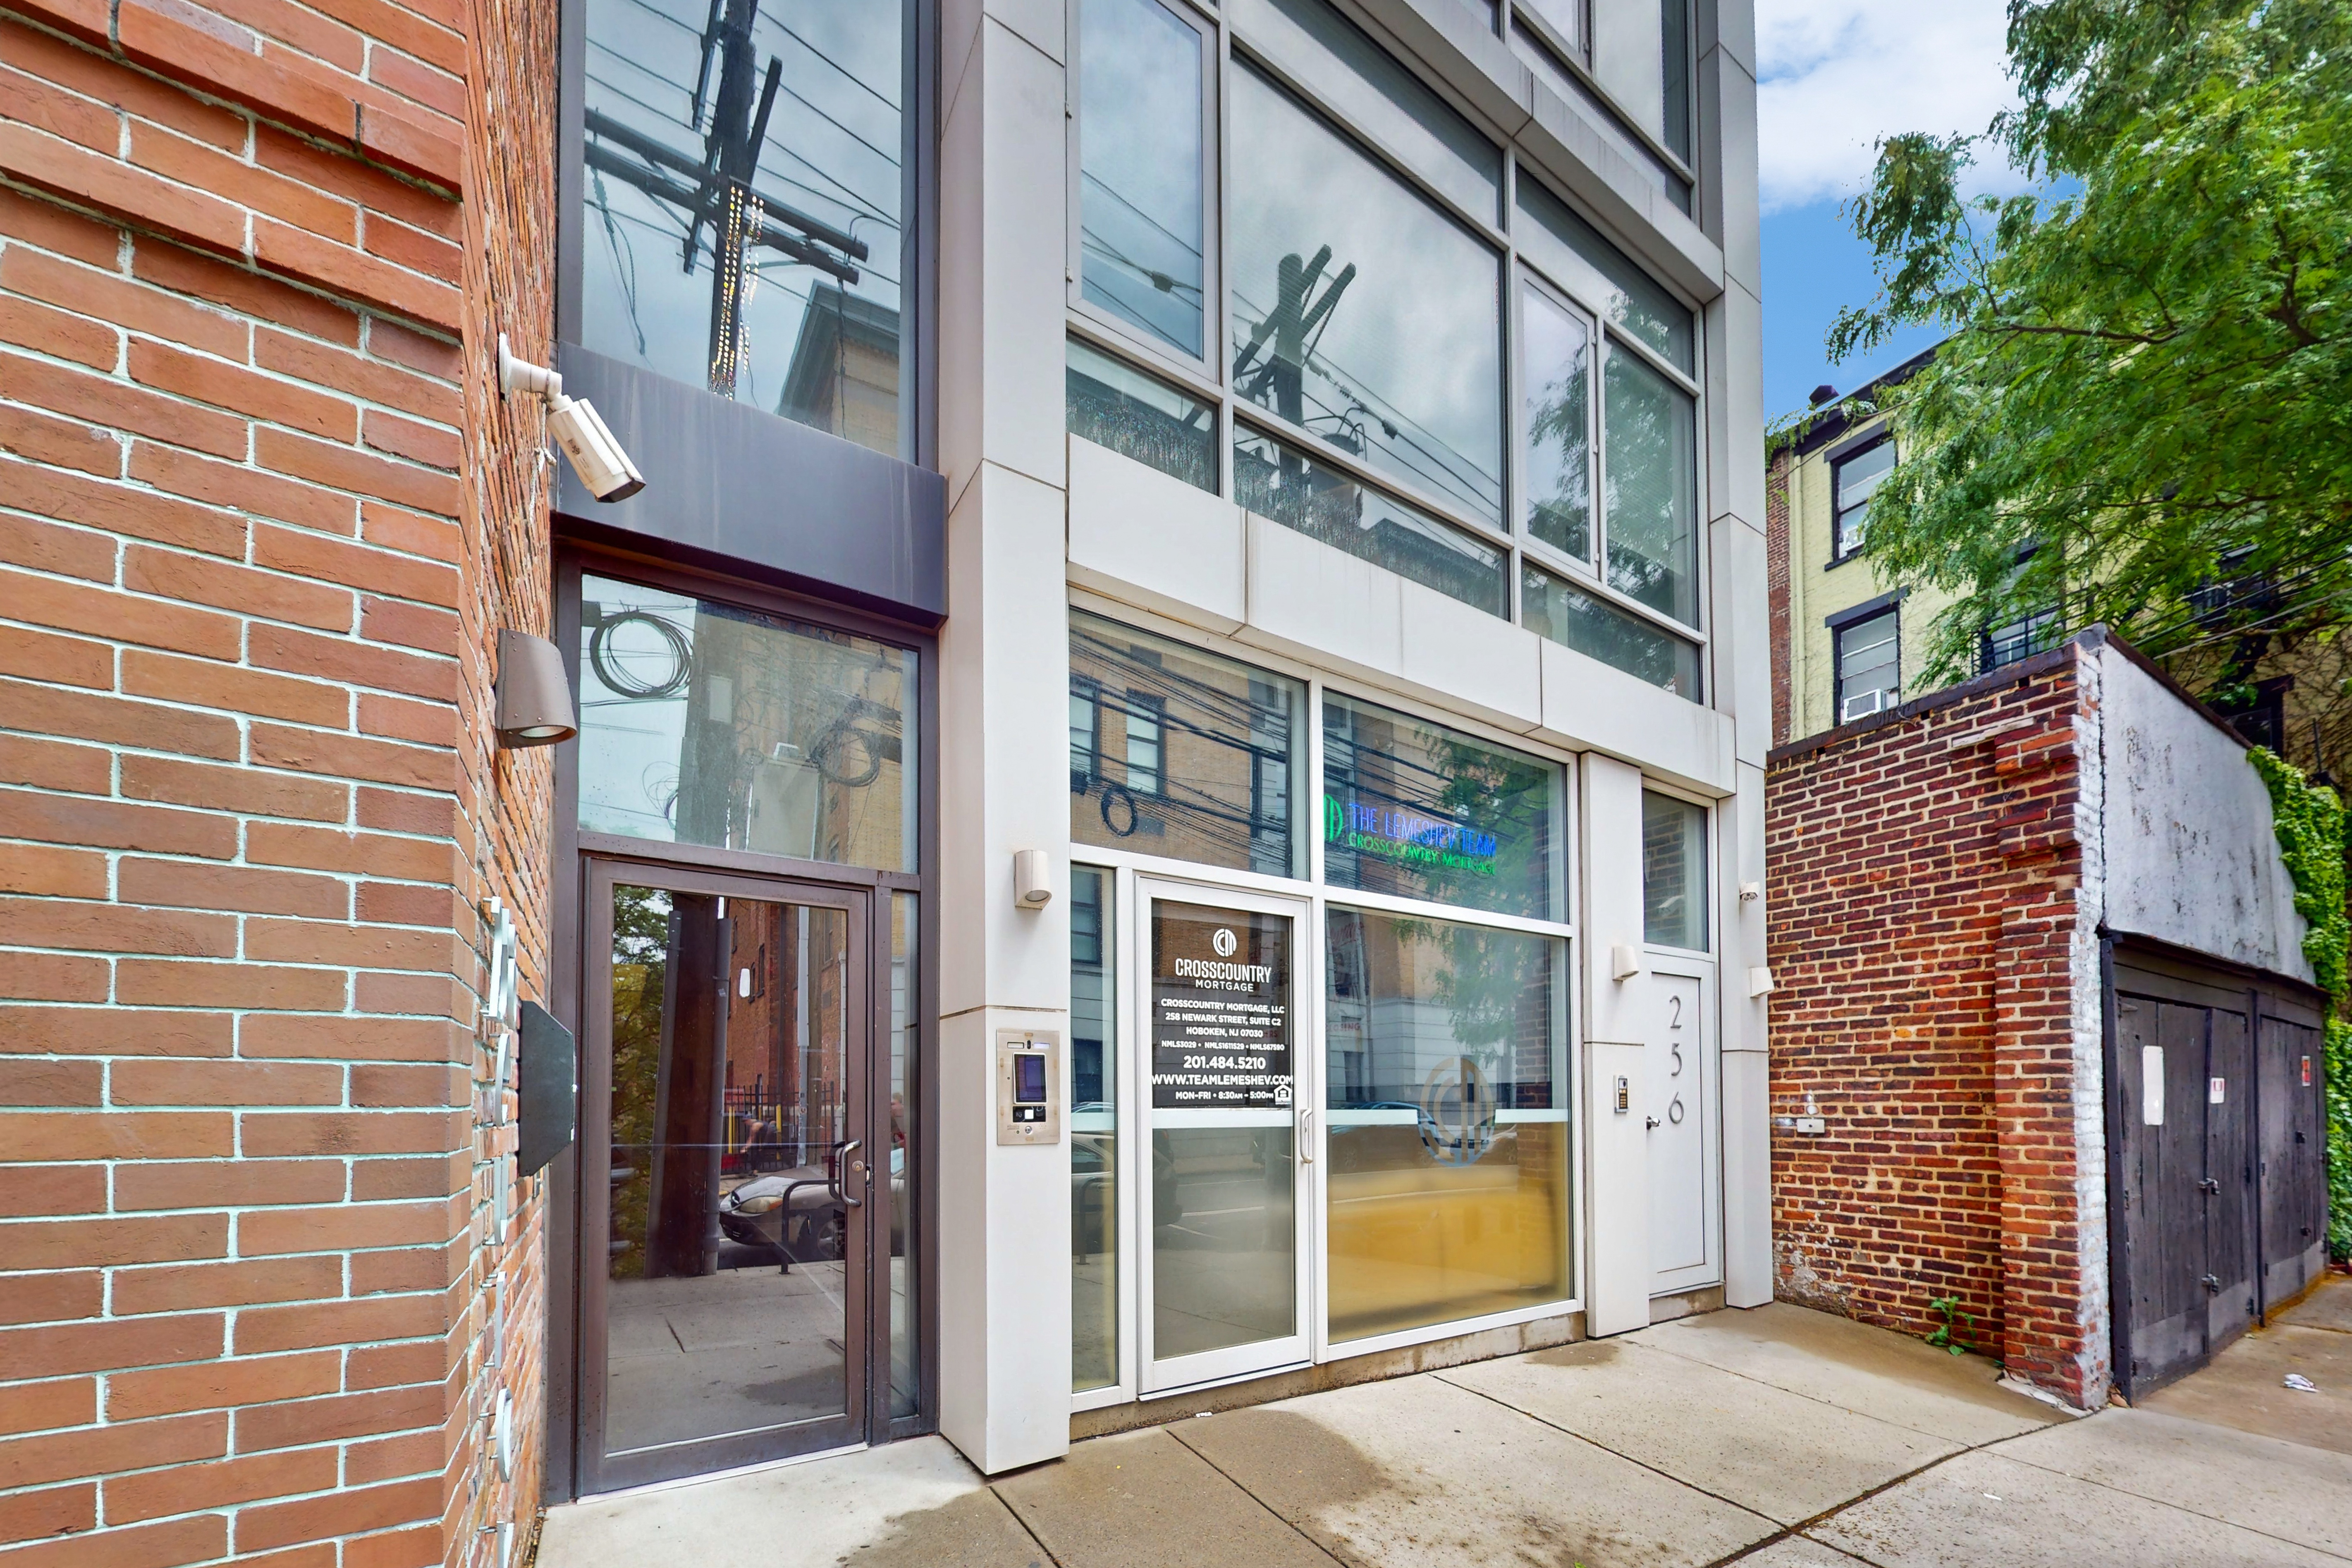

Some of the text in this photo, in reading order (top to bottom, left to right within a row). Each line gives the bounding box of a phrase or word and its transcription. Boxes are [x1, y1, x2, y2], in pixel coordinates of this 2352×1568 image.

[1348, 802, 1496, 858] THE LEMESHEV TEAM
[1348, 832, 1438, 863] CROSSCOUNTRY
[1175, 958, 1272, 983] CROSSCOUNTRY
[1195, 979, 1254, 992] MORTGAGE
[1161, 998, 1285, 1014] CROSSCOUNTRY MORTGAGE, LLC
[1165, 1012, 1282, 1026] 258 NEWARK STREET, SUITE C2
[1186, 1026, 1228, 1037] HOBOKEN,
[1229, 1028, 1239, 1037] NJ
[1240, 1029, 1264, 1038] 07030
[1161, 1040, 1197, 1049] NMLS3029
[1250, 1043, 1285, 1051] NMLS67590
[1183, 1055, 1267, 1070] 201.484.5210
[1151, 1073, 1293, 1085] WWW.TEAMLEMESHEV.COM
[1175, 1091, 1212, 1100] MON-FRI
[1218, 1091, 1243, 1100] 8:30AM
[1250, 1091, 1274, 1099] 5:00PM
